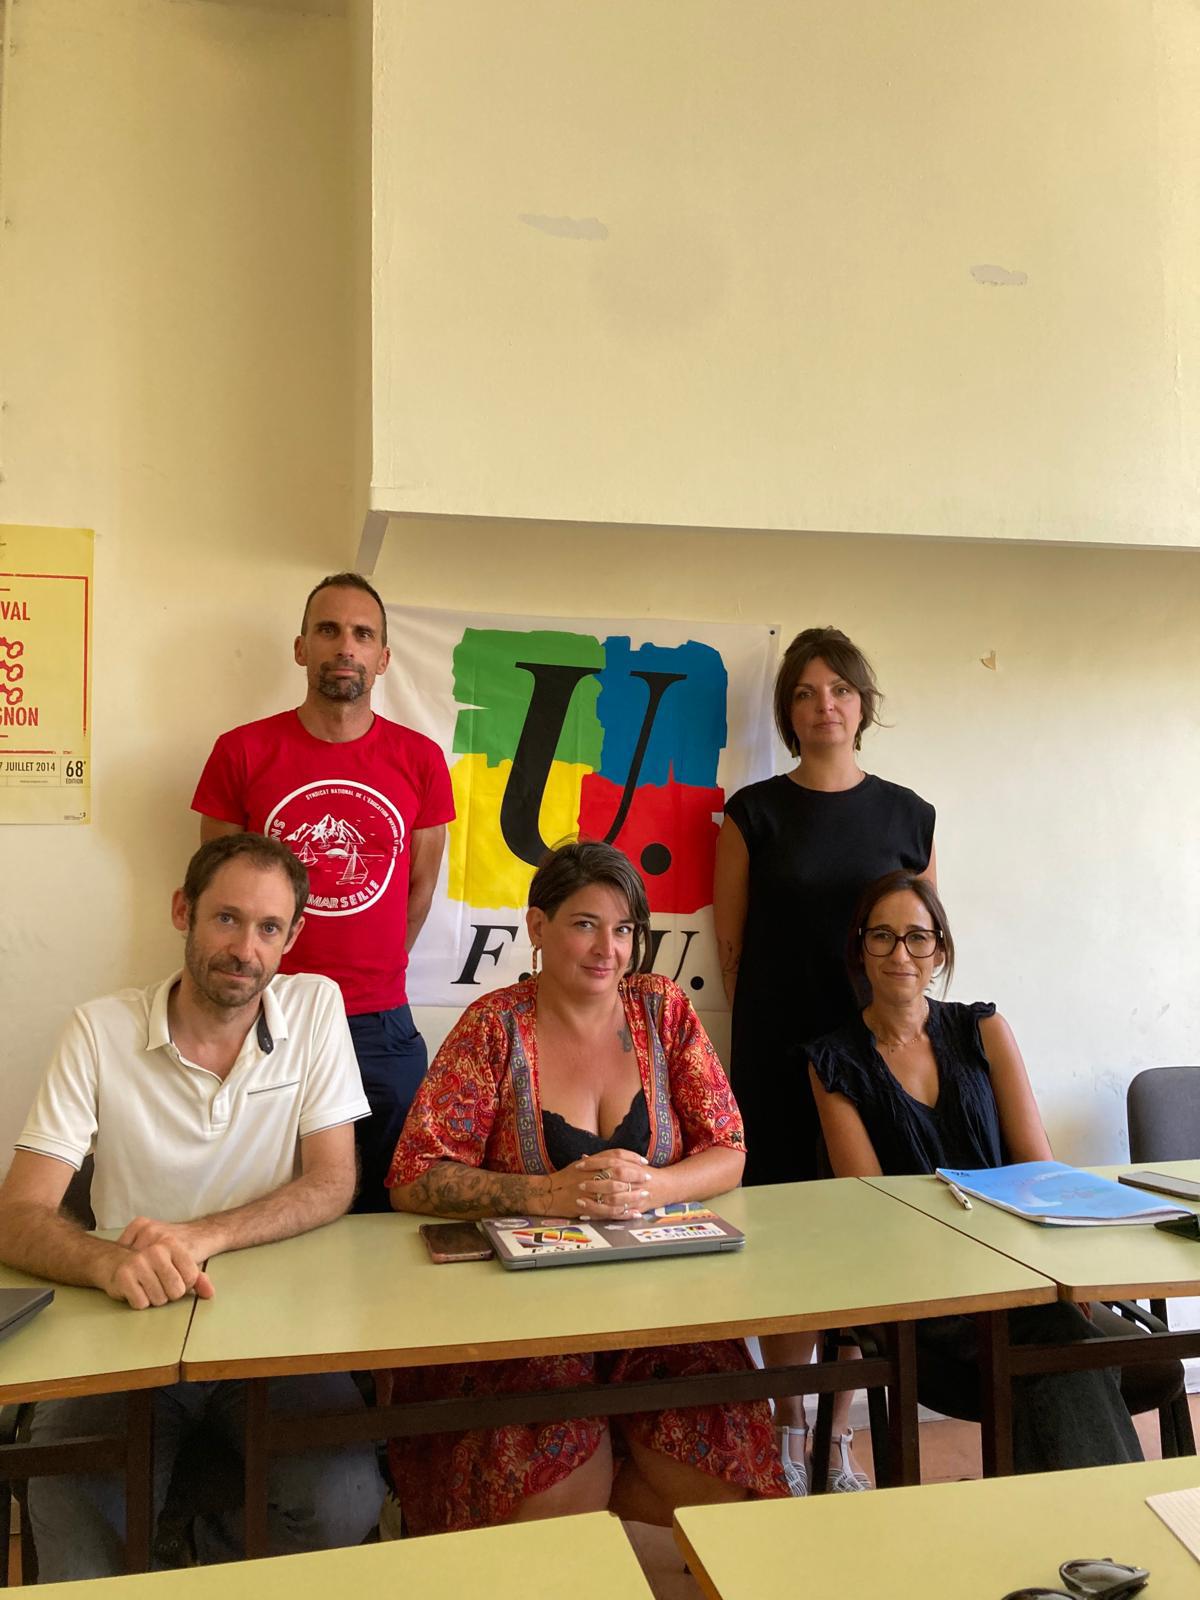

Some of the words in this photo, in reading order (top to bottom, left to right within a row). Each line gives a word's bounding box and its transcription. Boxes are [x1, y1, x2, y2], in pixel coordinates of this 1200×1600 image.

[0, 601, 31, 621] VAL
[0, 706, 39, 727] NON
[5, 761, 34, 772] JUILLET
[36, 761, 56, 772] 2014
[305, 788, 329, 801] SYNDICAT
[330, 788, 354, 796] NATIONAL
